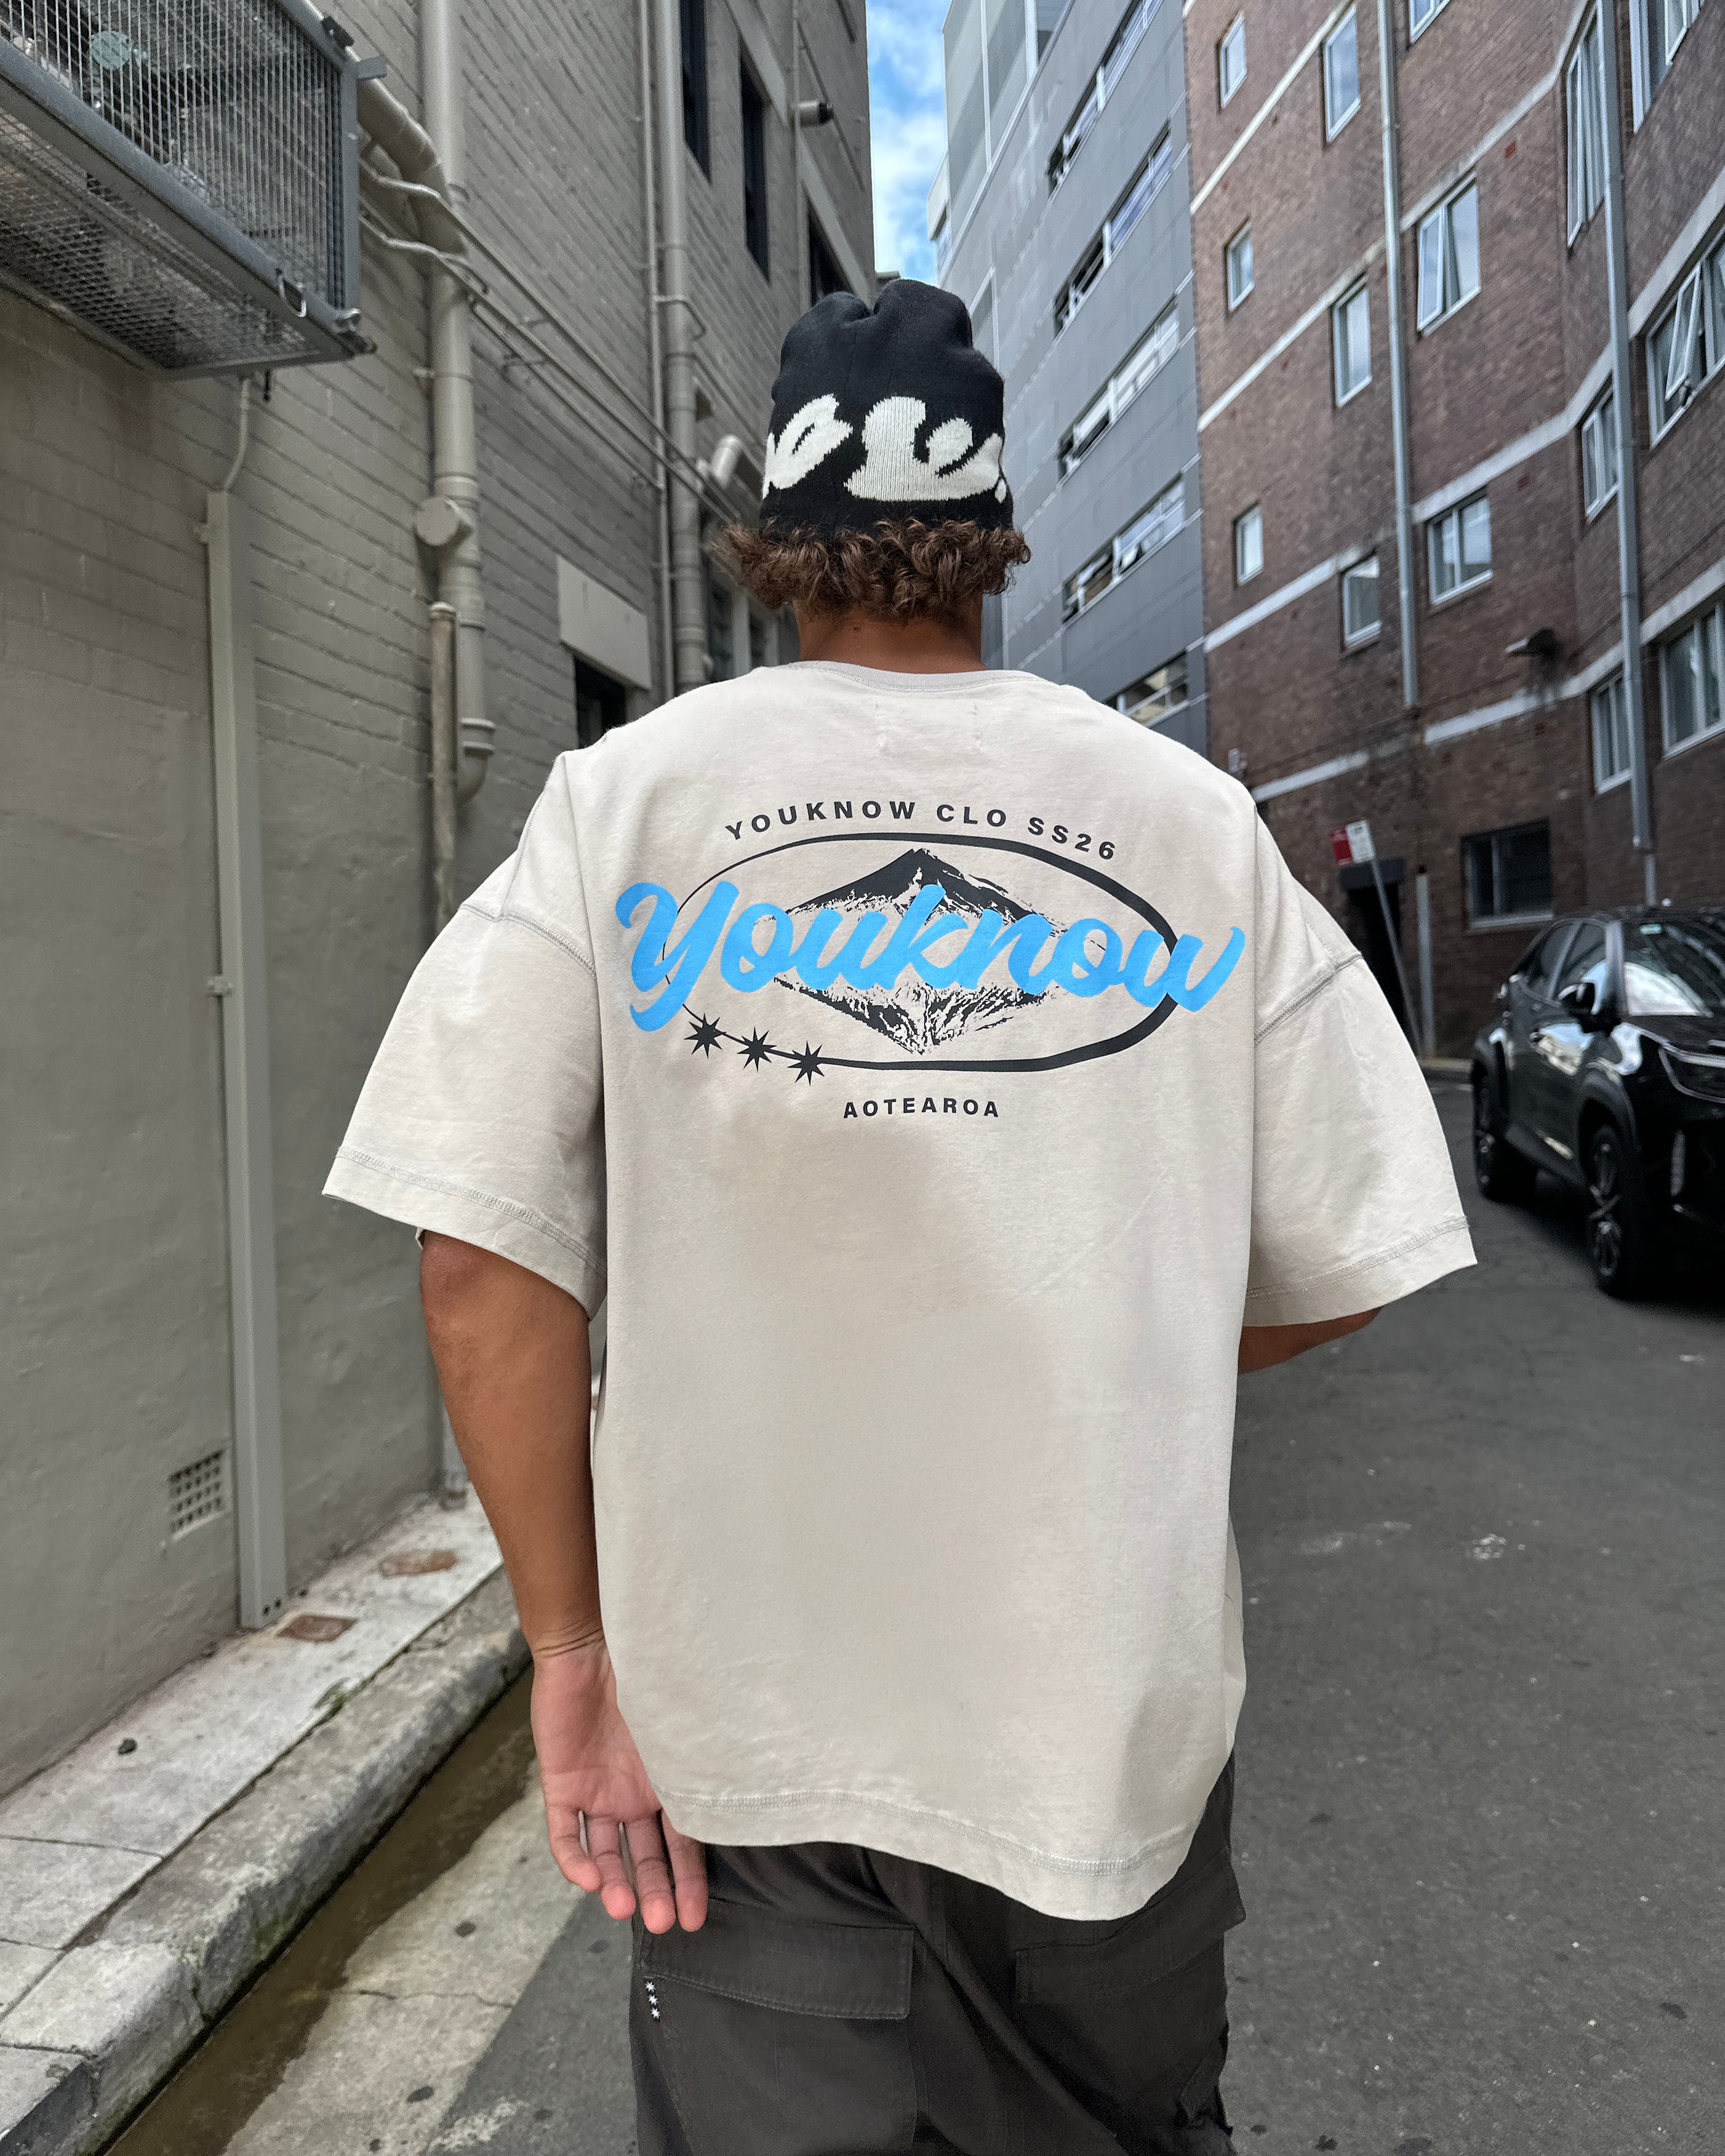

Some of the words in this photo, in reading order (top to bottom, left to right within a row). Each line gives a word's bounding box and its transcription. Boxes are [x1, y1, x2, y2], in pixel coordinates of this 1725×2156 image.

[724, 800, 916, 840] YOUKNOW
[936, 804, 1007, 827] CLO
[1027, 817, 1116, 861] SS26
[615, 881, 1246, 1032] Youknow
[843, 1097, 999, 1119] AOTEAROA
